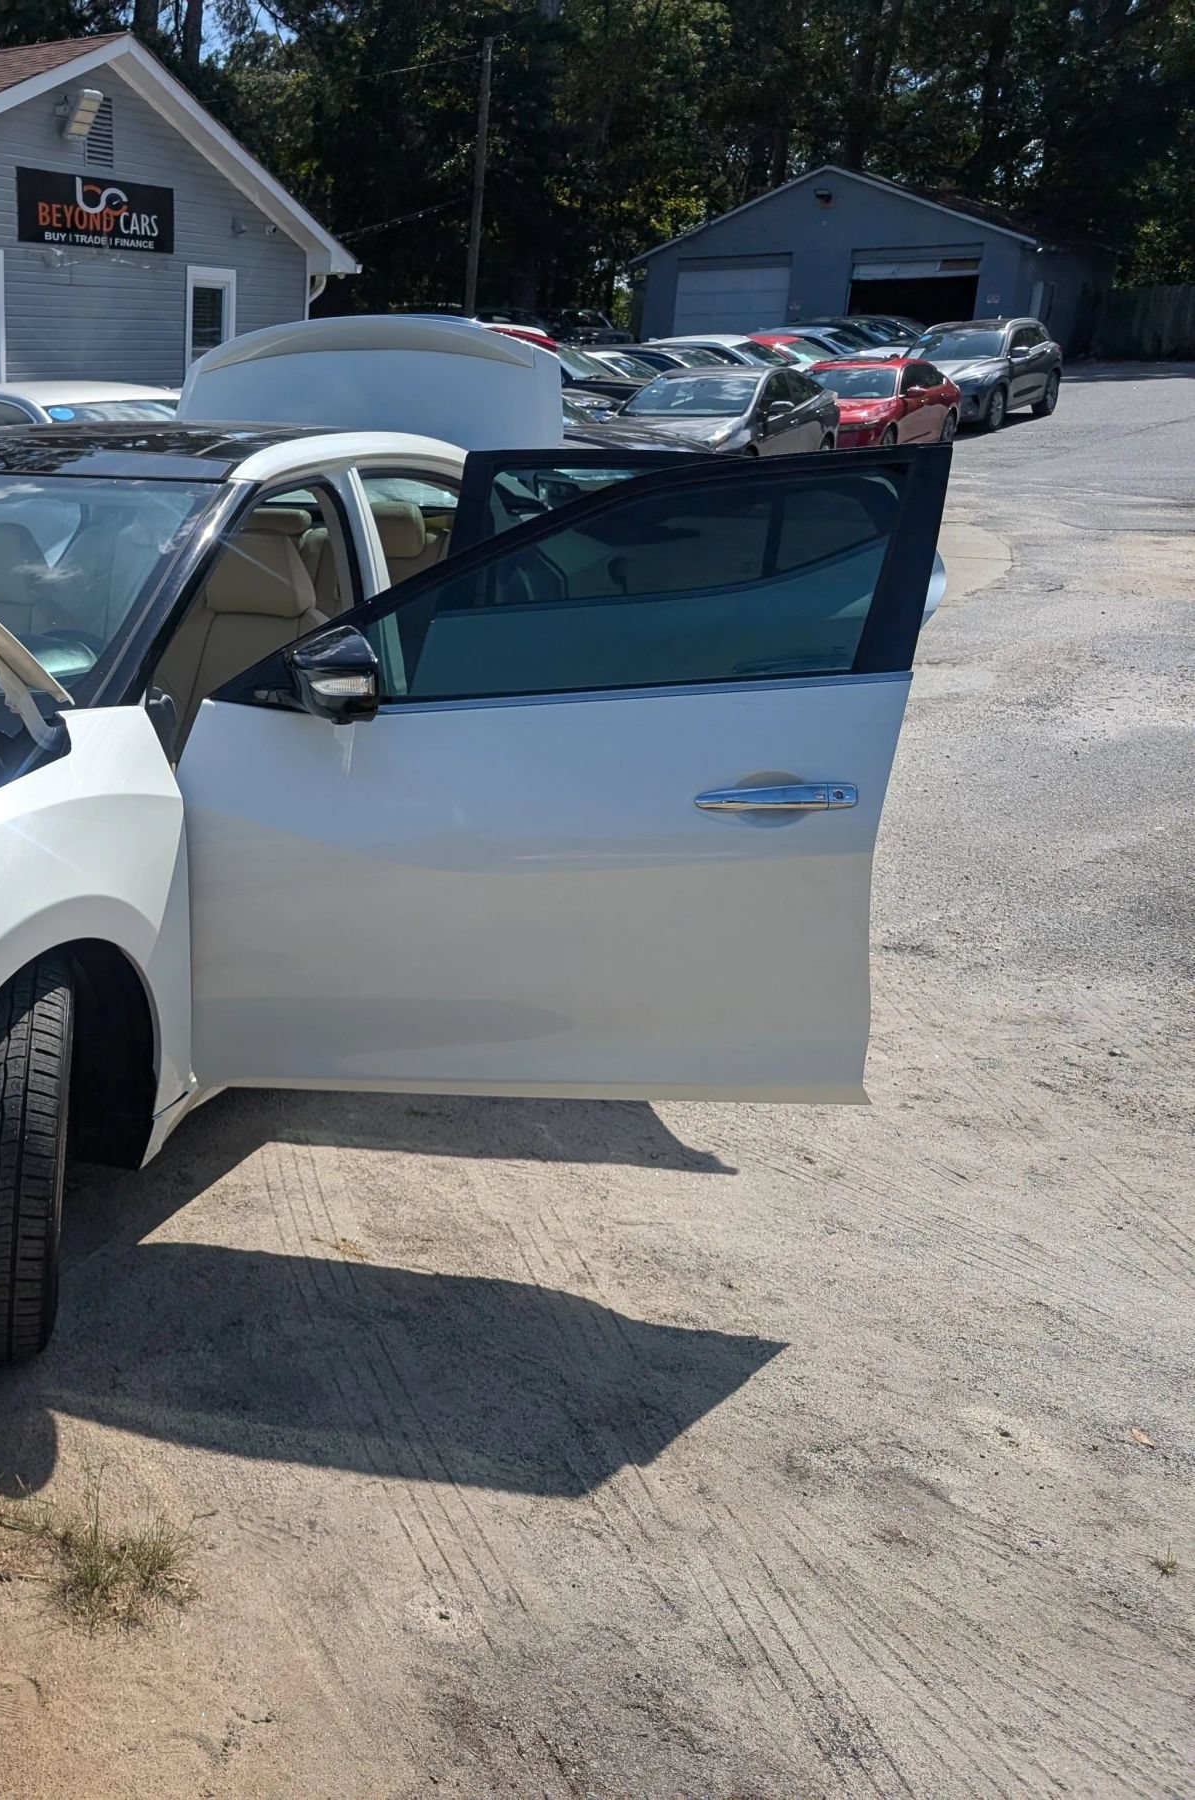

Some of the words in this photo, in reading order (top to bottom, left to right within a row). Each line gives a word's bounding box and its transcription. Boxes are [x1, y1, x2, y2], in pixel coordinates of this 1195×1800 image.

[37, 201, 115, 233] BEYOND
[119, 211, 159, 238] CARS
[44, 231, 67, 242] BUY
[74, 234, 108, 245] TRADE
[114, 237, 155, 249] FINANCE
